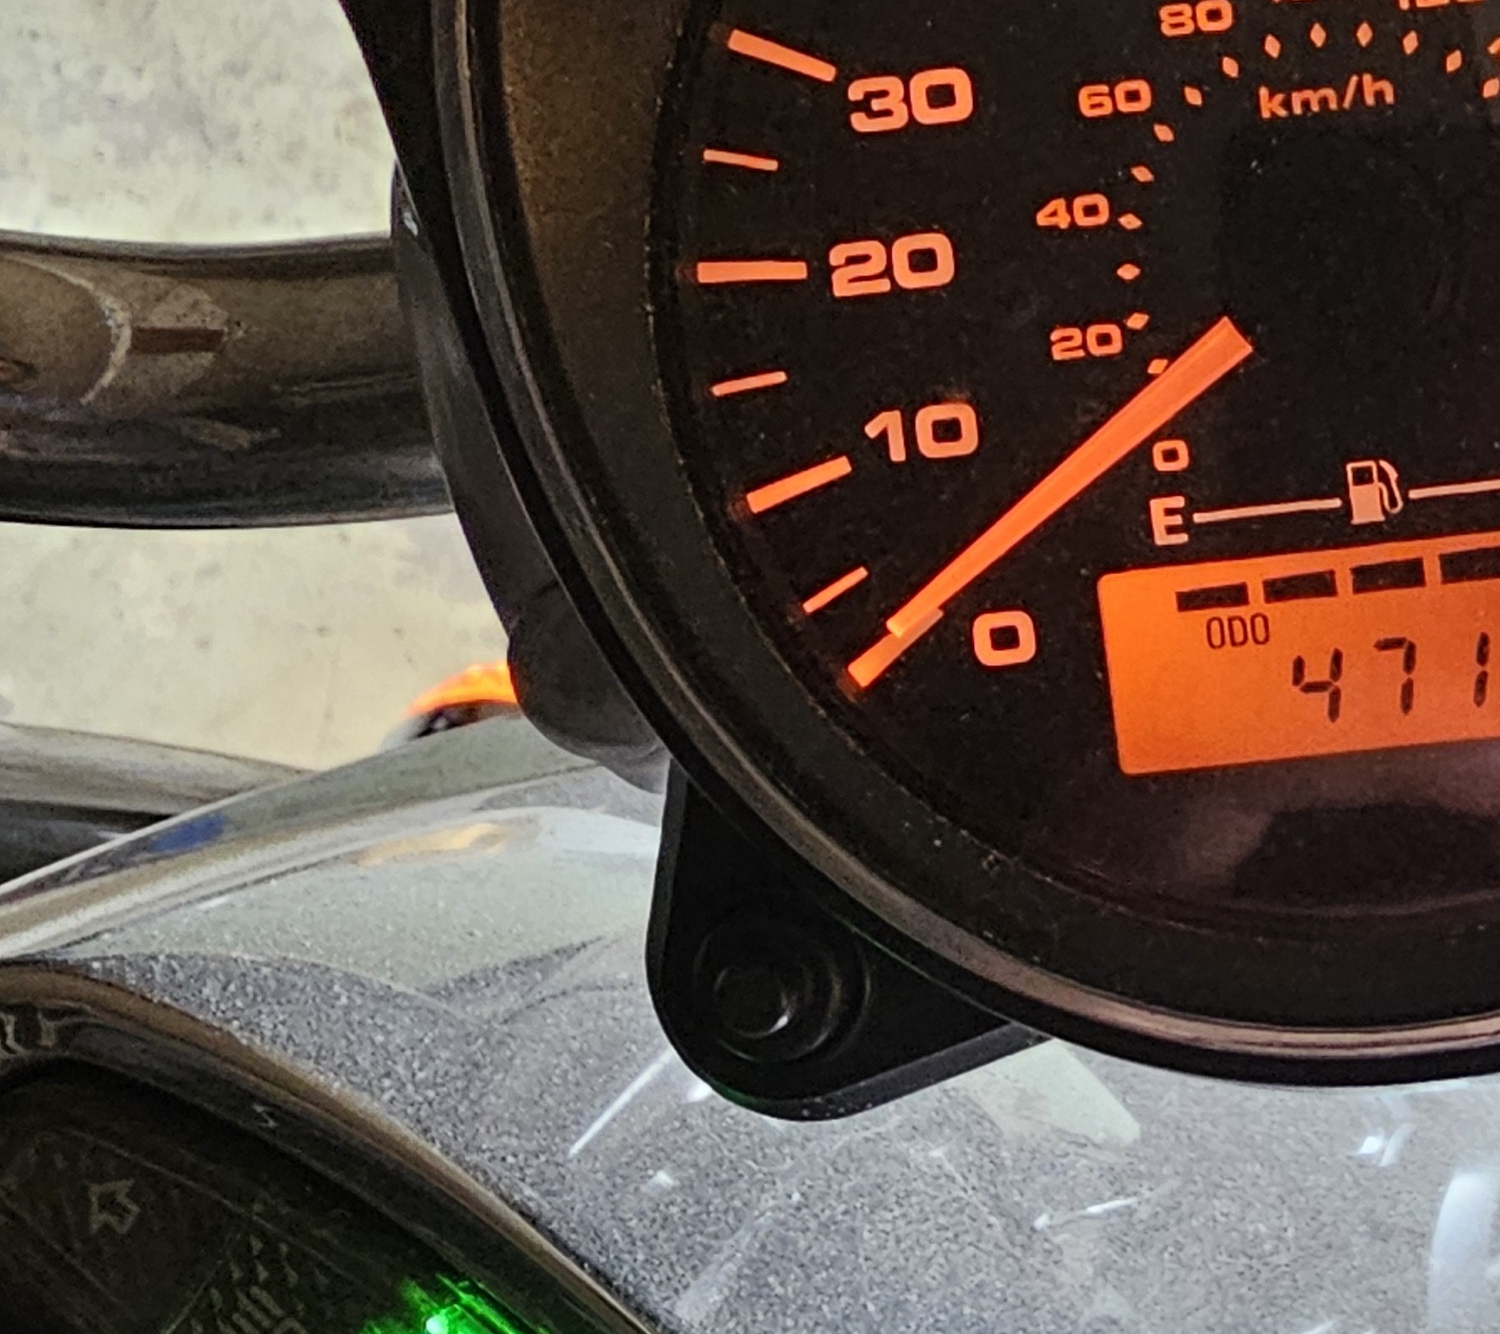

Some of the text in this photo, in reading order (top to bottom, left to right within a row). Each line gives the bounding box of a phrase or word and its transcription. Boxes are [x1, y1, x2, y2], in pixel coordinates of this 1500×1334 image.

[848, 67, 973, 132] 30
[1078, 79, 1151, 117] 60
[1259, 74, 1394, 118] km/h
[1036, 194, 1109, 229] 40
[829, 233, 954, 297] 20
[1050, 324, 1122, 360] 20
[865, 401, 978, 462] 10
[1152, 439, 1189, 471] 0
[1149, 496, 1188, 546] E
[972, 610, 1036, 666] 0
[1207, 613, 1270, 649] ODO
